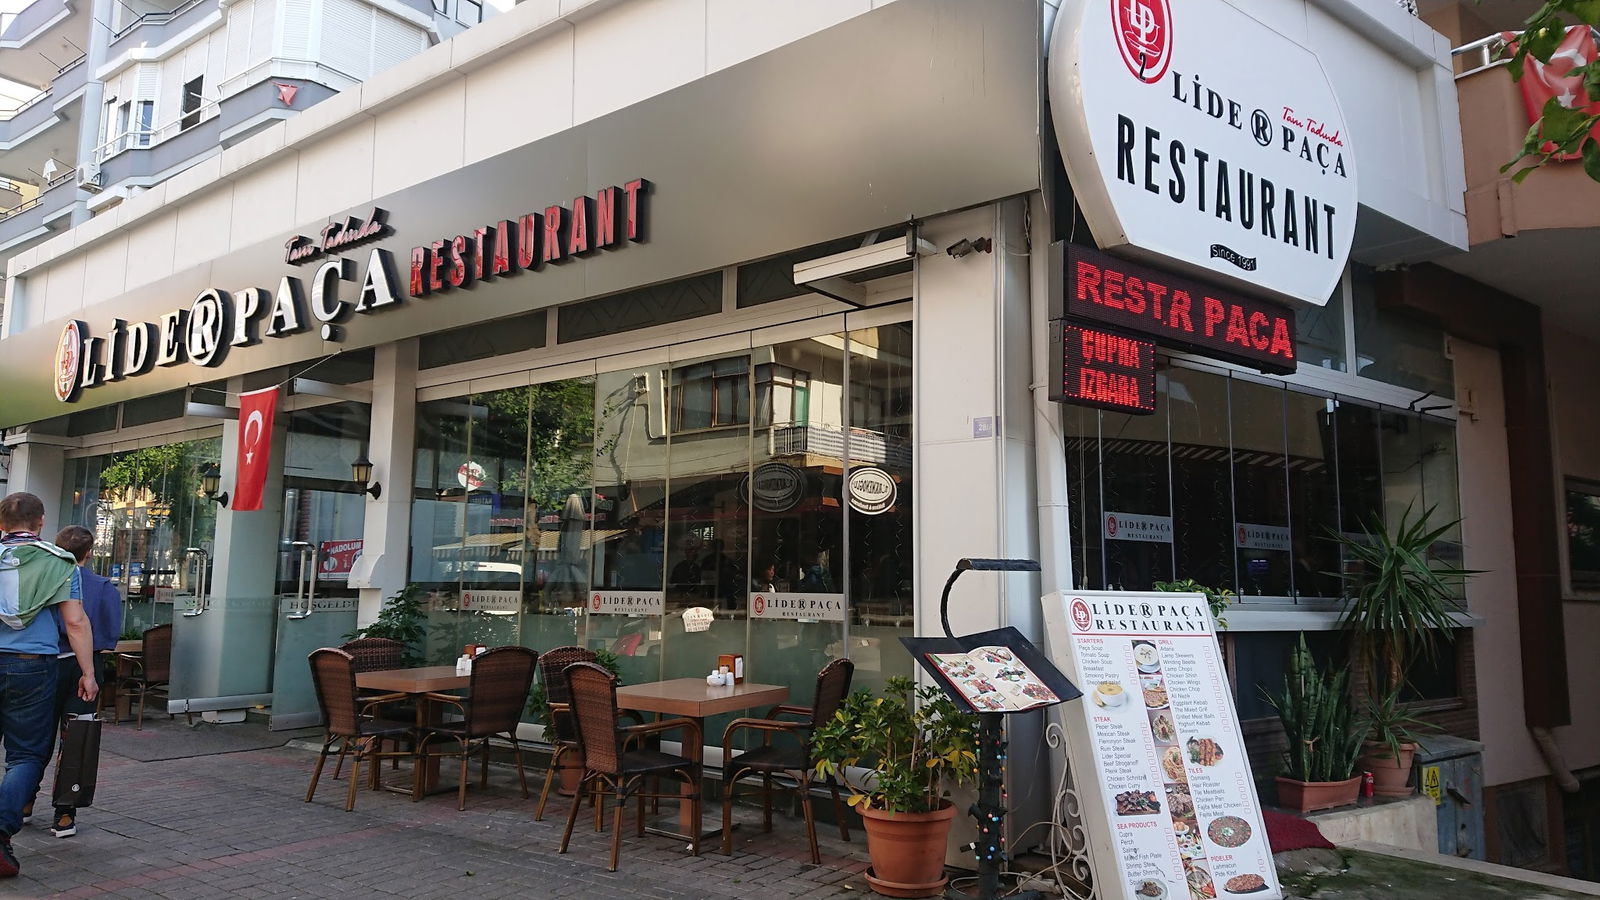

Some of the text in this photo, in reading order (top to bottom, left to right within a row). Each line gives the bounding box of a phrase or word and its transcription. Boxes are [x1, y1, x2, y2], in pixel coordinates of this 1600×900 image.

[1138, 52, 1146, 81] 2
[1281, 125, 1347, 178] PAÇA
[1117, 113, 1336, 260] RESTAURANT
[230, 247, 396, 347] PAÇA
[409, 178, 645, 297] RESTAURANT
[1212, 246, 1255, 270] Since 1991
[810, 599, 841, 611] PAÇA
[1157, 604, 1202, 620] PAÇA
[1095, 620, 1205, 631] RESTAURANT
[1128, 821, 1157, 829] PRODUCTS
[1126, 862, 1142, 870] Shrimp
[1142, 869, 1159, 877] Shrimp
